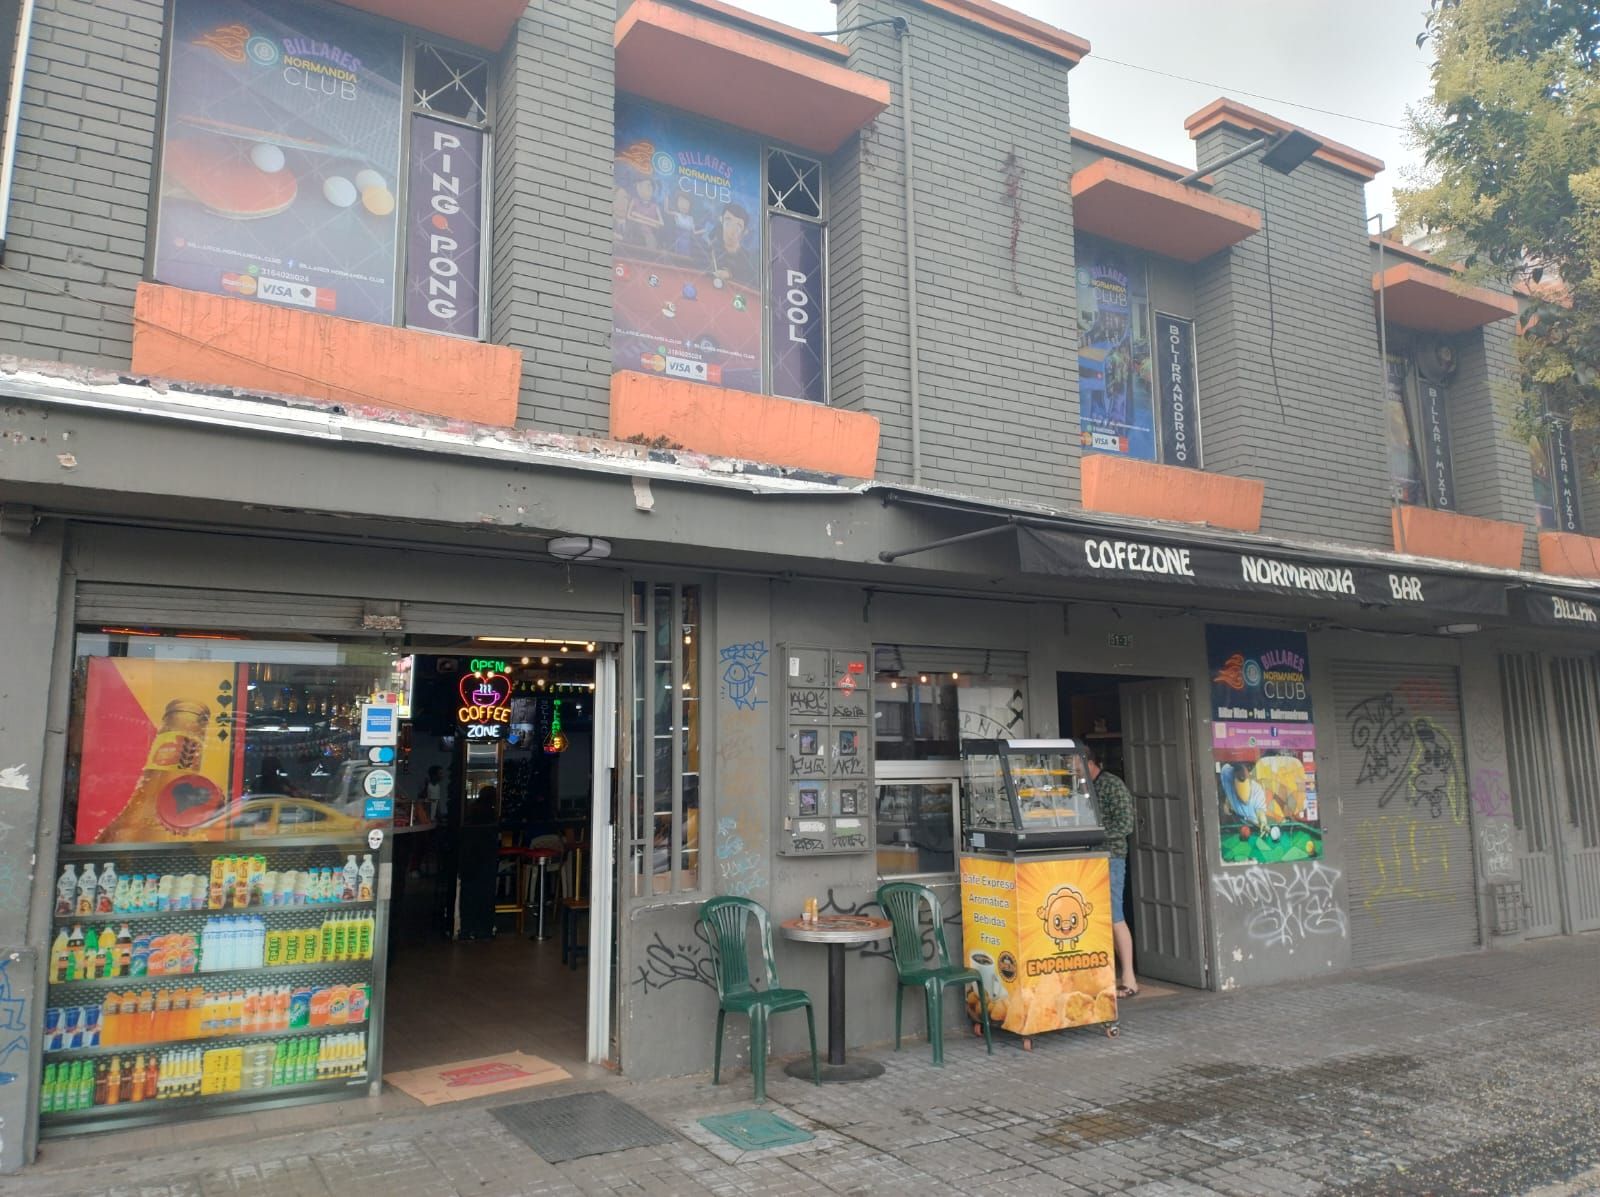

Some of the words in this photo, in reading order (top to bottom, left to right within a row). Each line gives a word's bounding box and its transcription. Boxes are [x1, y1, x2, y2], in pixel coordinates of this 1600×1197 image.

[283, 38, 361, 72] BILLARES
[284, 55, 357, 83] NORMANDIA
[284, 66, 357, 100] CLUB
[431, 131, 461, 215] PING
[678, 151, 734, 179] BILLARES
[678, 165, 731, 188] NORMANDIA
[678, 175, 732, 204] CLUB
[427, 234, 459, 320] PONG
[262, 284, 293, 298] VISA
[786, 269, 809, 343] POOL
[669, 361, 691, 374] VISA
[1436, 460, 1448, 506] MIXTO
[1085, 539, 1195, 577] COFEZONE
[1241, 555, 1356, 595] NORMANDIA
[1389, 574, 1424, 601] BAR
[470, 658, 505, 673] OPEN
[1261, 648, 1305, 673] BILLARES
[1263, 671, 1305, 682] NORMANDIA
[1264, 681, 1307, 701] CLUB
[458, 704, 512, 723] COFFEE
[466, 724, 501, 738] ZONE
[981, 875, 1015, 891] Expreso
[973, 912, 1006, 928] Bebidas
[269, 937, 279, 961] SPEED
[1026, 951, 1109, 977] EMPANADAS
